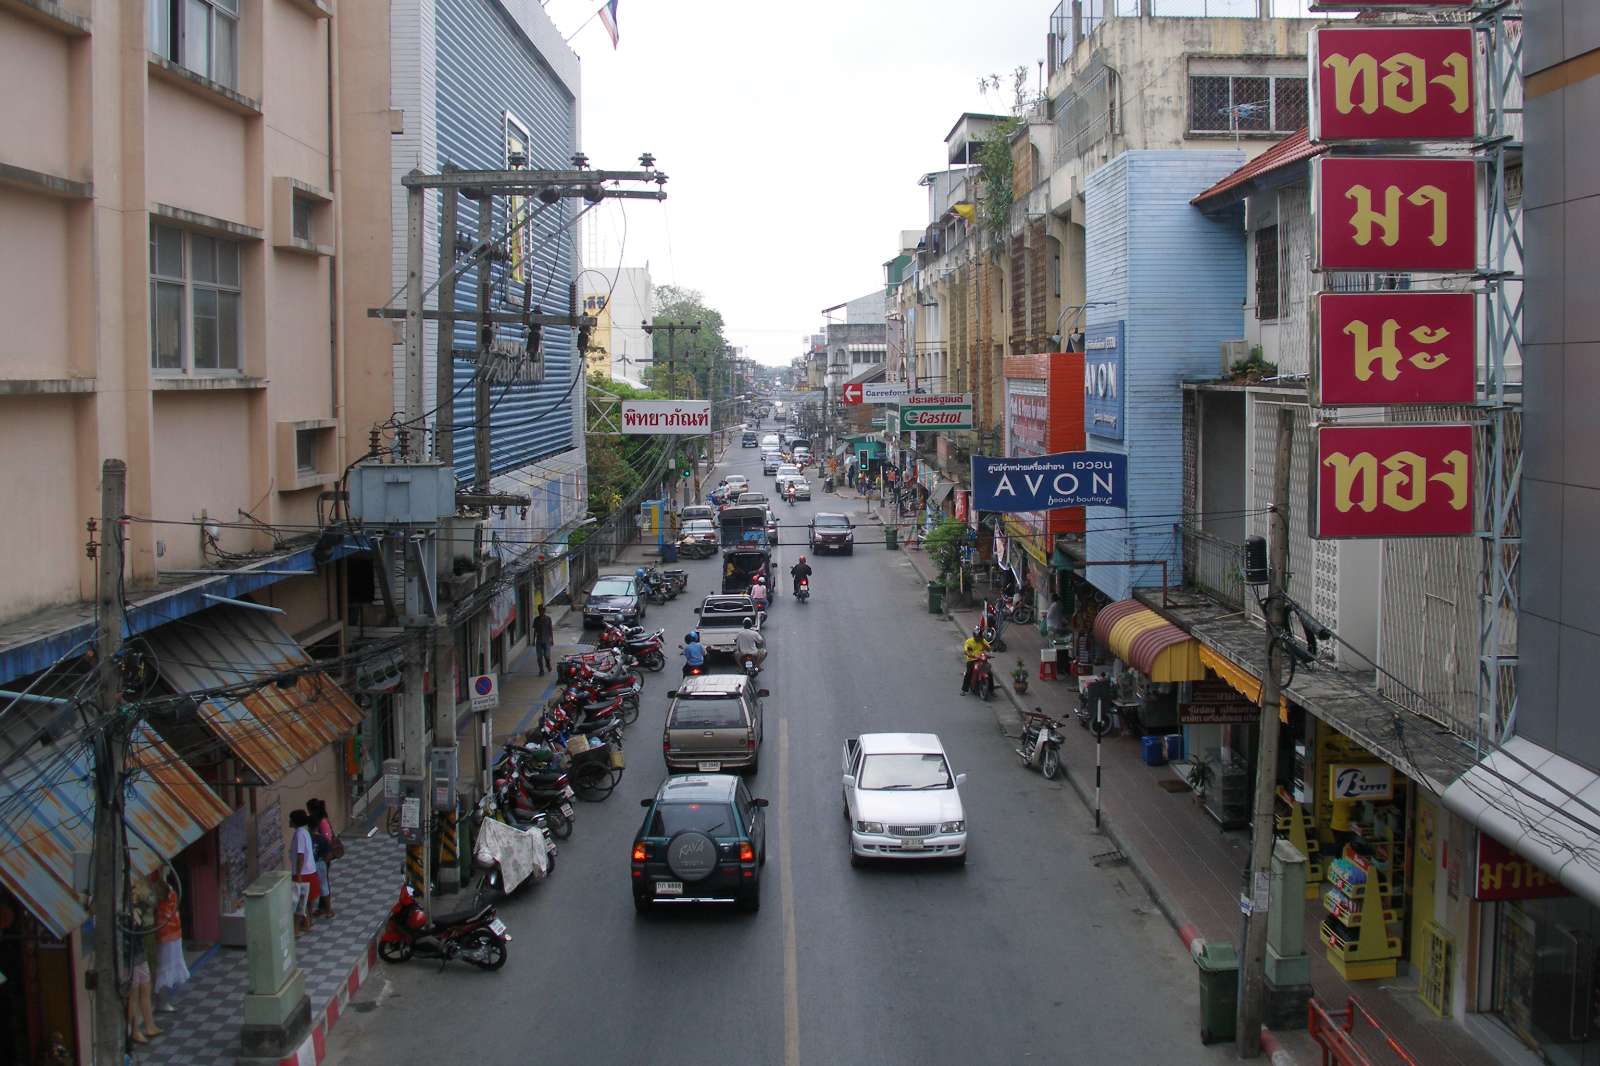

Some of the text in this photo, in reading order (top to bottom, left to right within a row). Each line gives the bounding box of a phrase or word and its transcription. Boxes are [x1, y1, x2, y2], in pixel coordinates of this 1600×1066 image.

[1322, 52, 1469, 115] ทอง
[1344, 184, 1448, 247] มา
[1343, 318, 1451, 382] นะ
[865, 389, 908, 397] Carrefour
[1085, 362, 1117, 400] AVON
[919, 411, 962, 424] Castrol
[1072, 461, 1113, 470] เอวอน
[1323, 449, 1469, 513] ทอง
[993, 471, 1113, 497] AVON
[1048, 495, 1113, 505] beauty boutique
